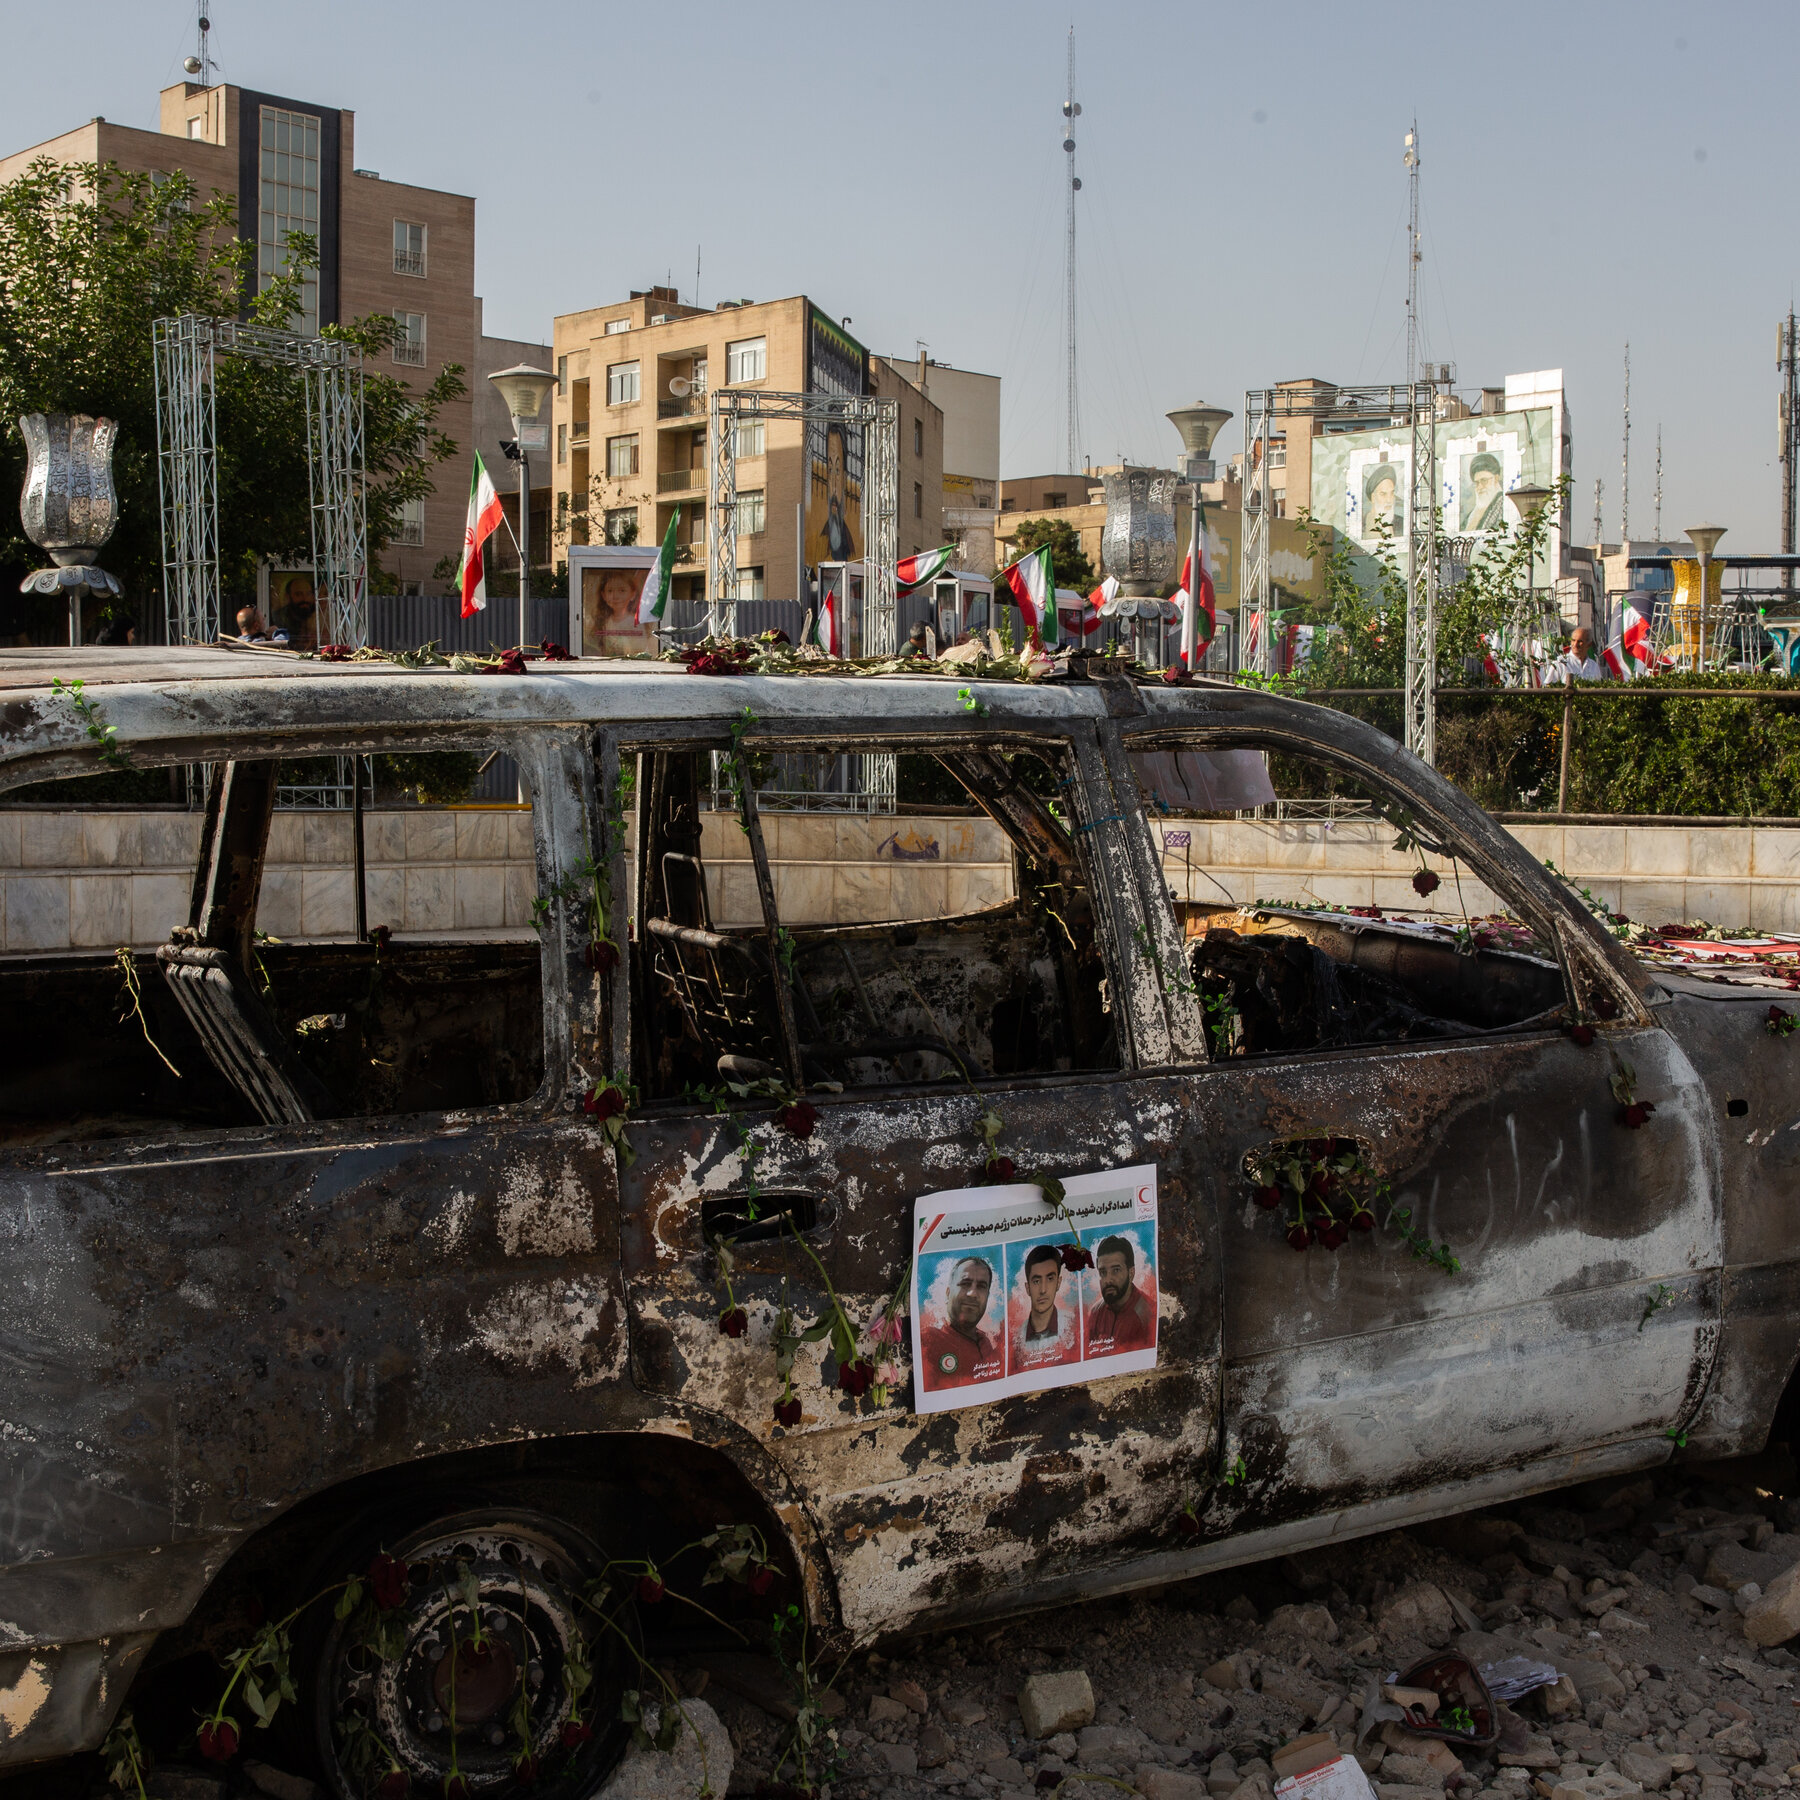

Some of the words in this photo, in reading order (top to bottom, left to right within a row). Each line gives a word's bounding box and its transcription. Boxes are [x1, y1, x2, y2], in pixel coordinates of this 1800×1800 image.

[1076, 1203, 1096, 1218] شهید
[1096, 1199, 1133, 1215] امدادگران
[994, 1218, 1010, 1233] رژیم
[1010, 1216, 1034, 1228] حملات
[940, 1223, 993, 1239] صهیونیستی
